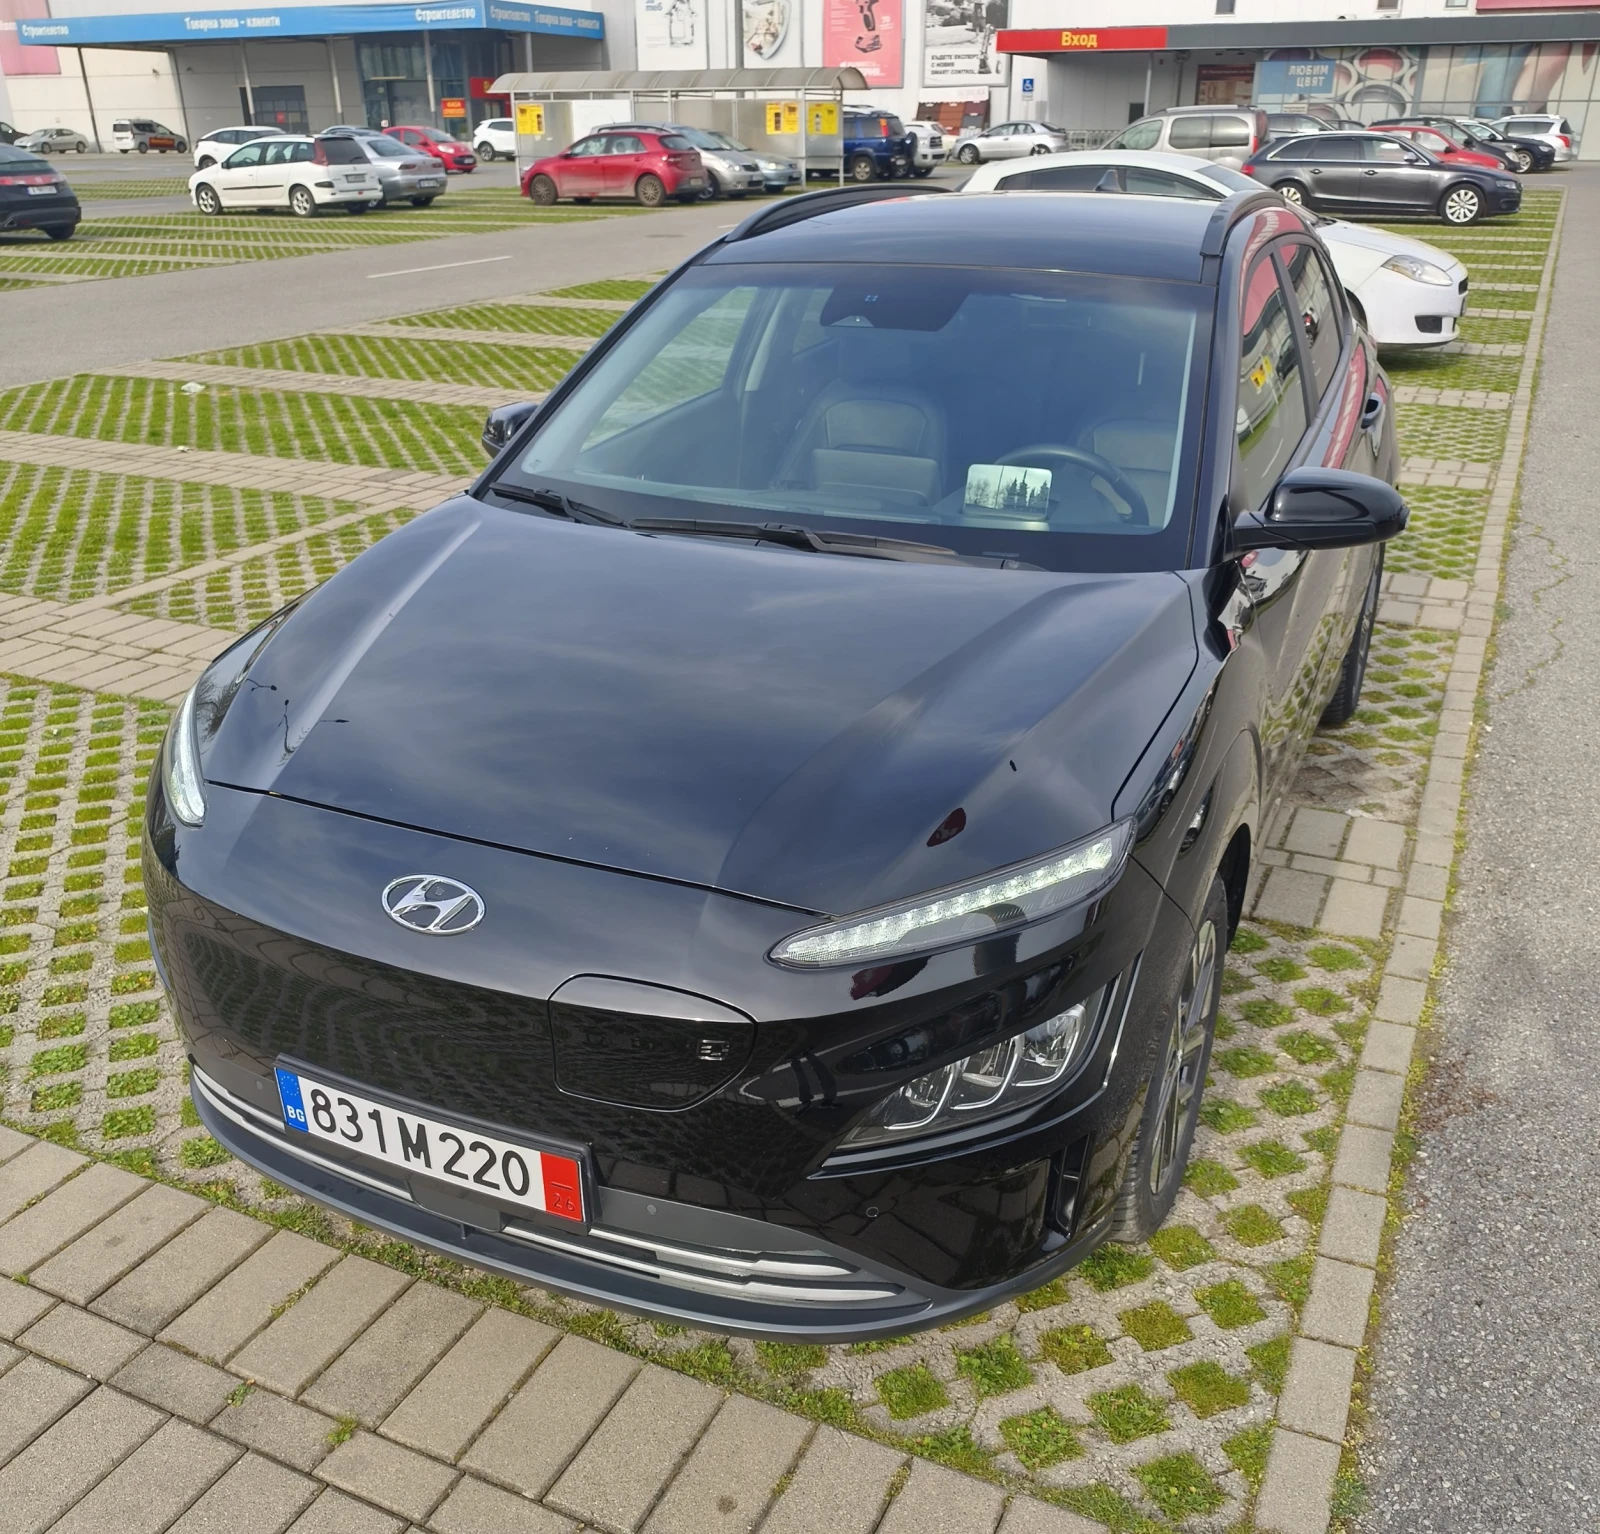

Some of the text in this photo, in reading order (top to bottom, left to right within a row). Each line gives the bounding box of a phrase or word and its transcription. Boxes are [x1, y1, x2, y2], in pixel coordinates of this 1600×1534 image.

[415, 8, 476, 23] Строителство
[1061, 32, 1098, 48] Вход
[1288, 65, 1329, 76] ЛЮБИМ
[1296, 77, 1325, 88] ЦВЯТ
[286, 1104, 305, 1123] BG
[553, 1192, 575, 1212] 26
